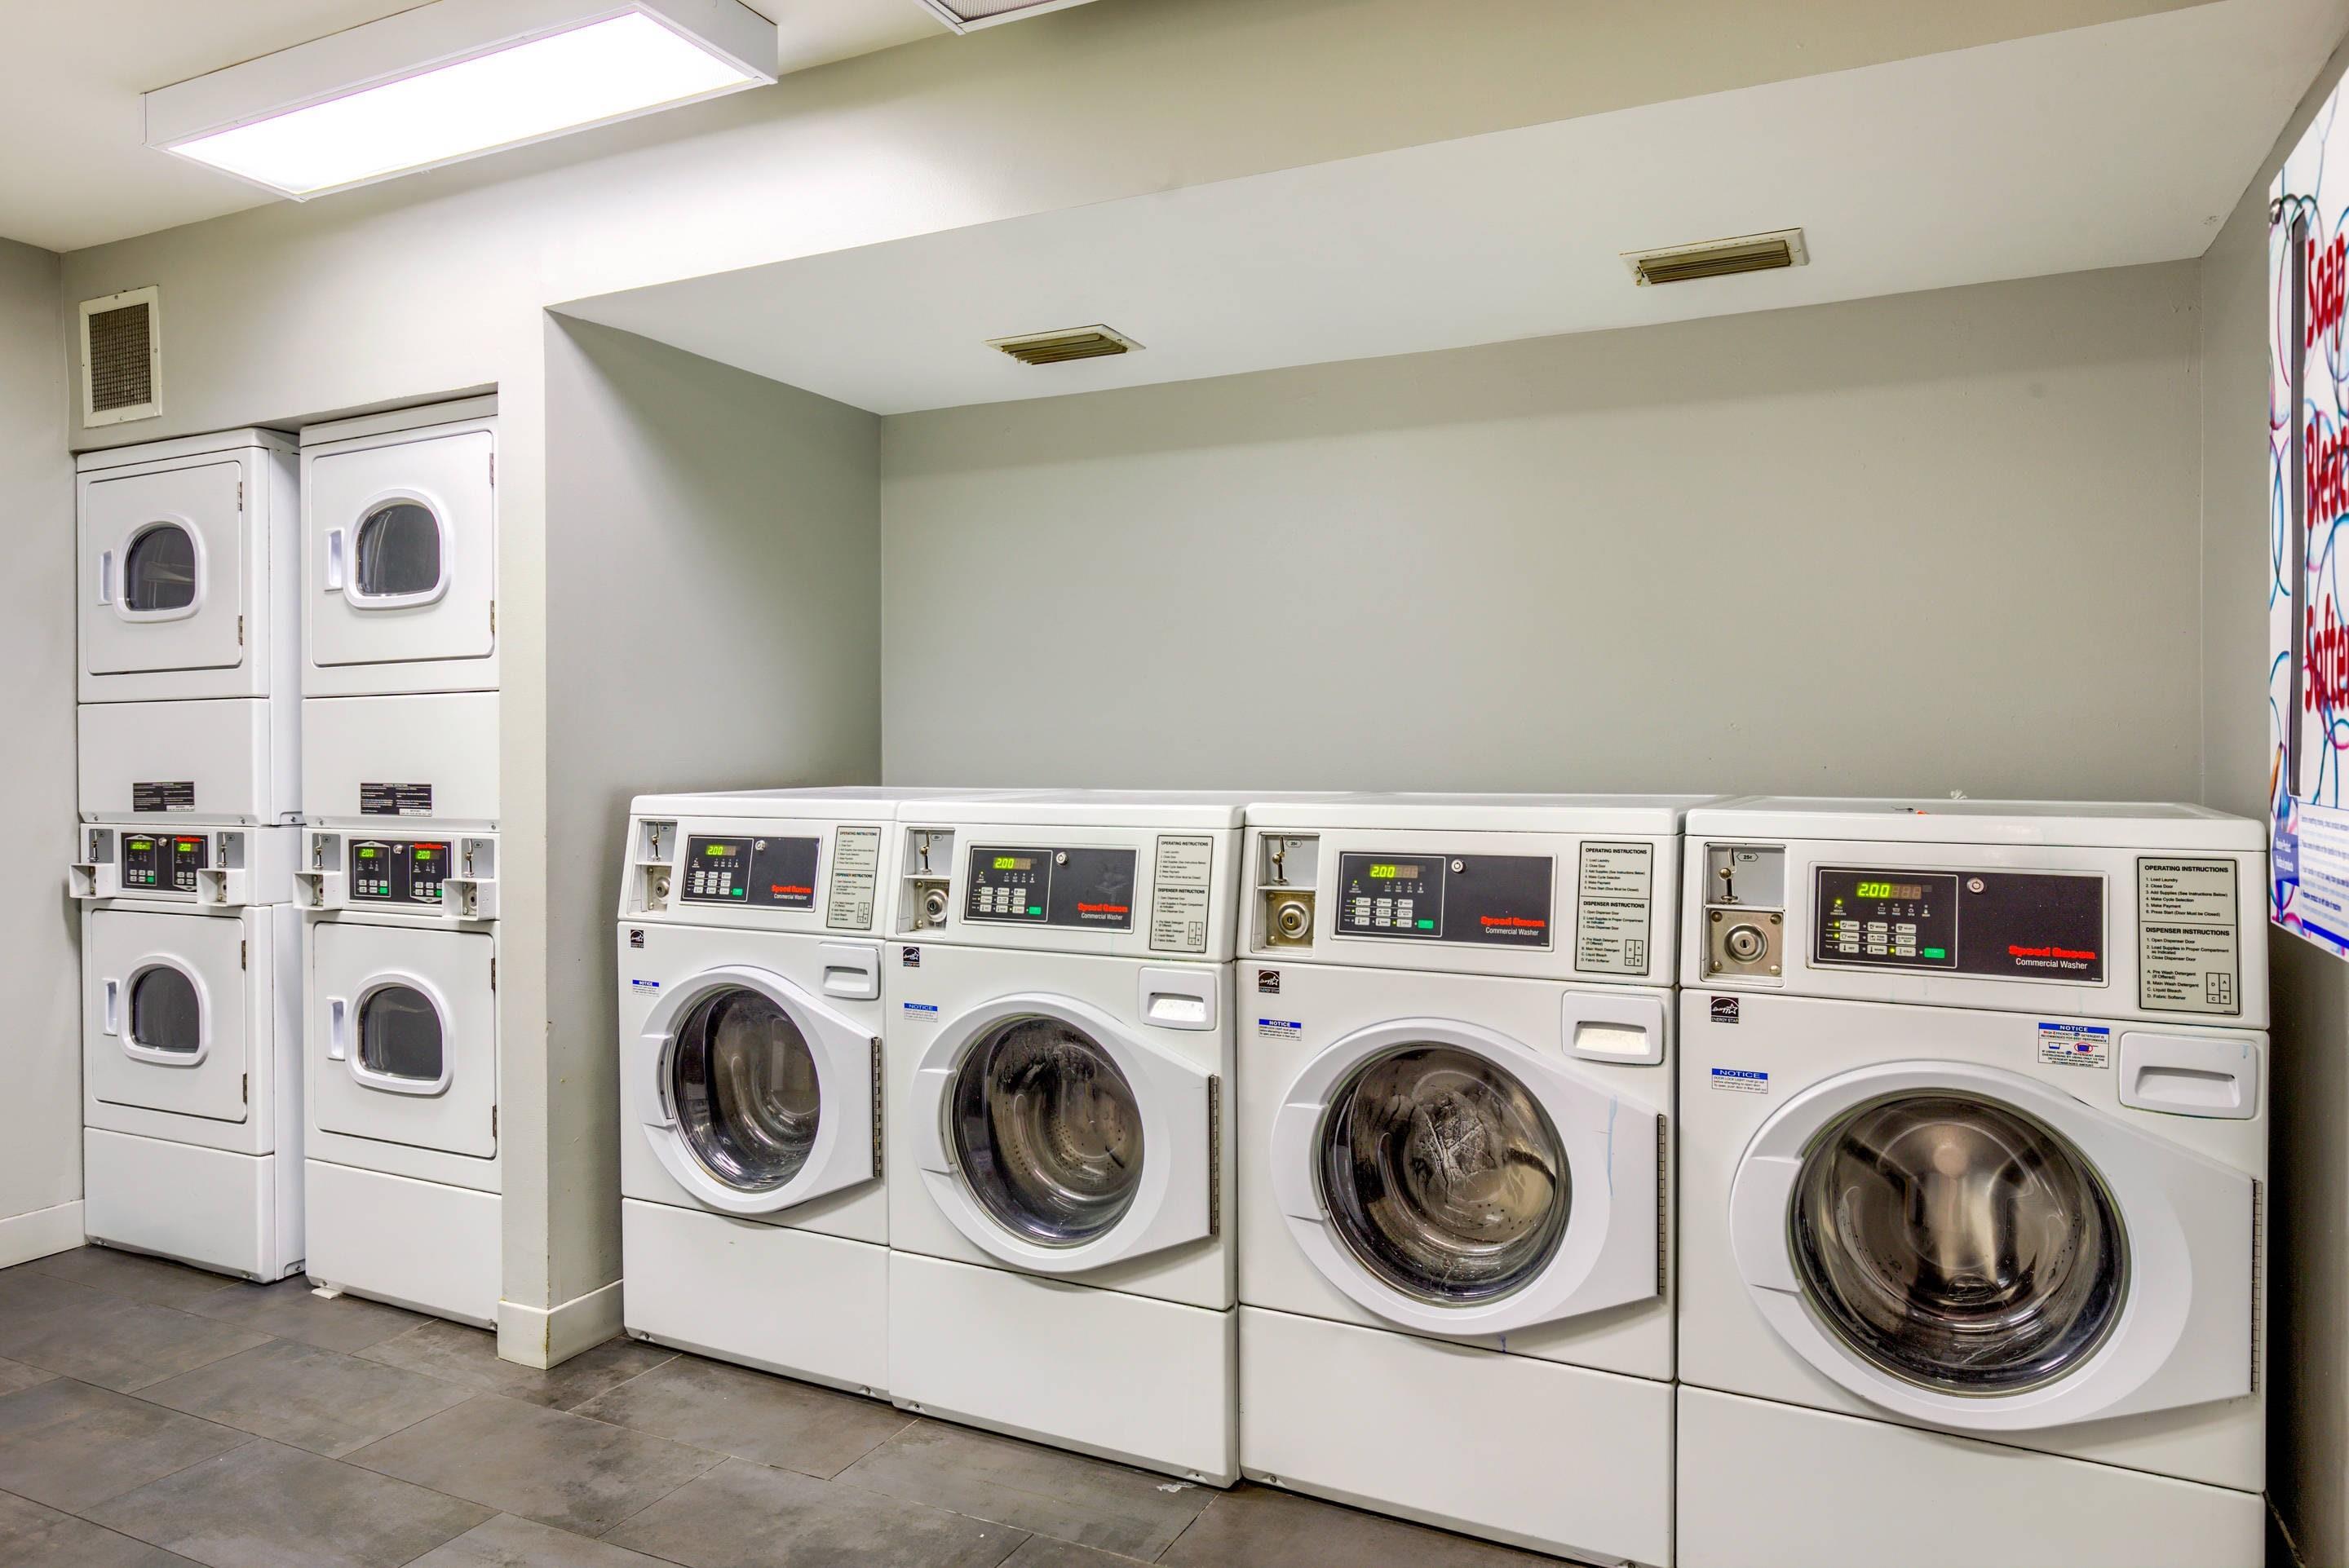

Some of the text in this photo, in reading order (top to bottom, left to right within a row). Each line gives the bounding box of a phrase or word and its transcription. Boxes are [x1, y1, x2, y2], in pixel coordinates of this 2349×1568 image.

[2307, 232, 2345, 352] Soap
[2306, 412, 2349, 530] Bleac
[2305, 594, 2349, 713] Softe
[1370, 866, 1395, 878] 2.00
[1858, 883, 1890, 897] 2.00
[2016, 958, 2088, 969] Commercial Washer
[1720, 1070, 1760, 1078] NOTICE
